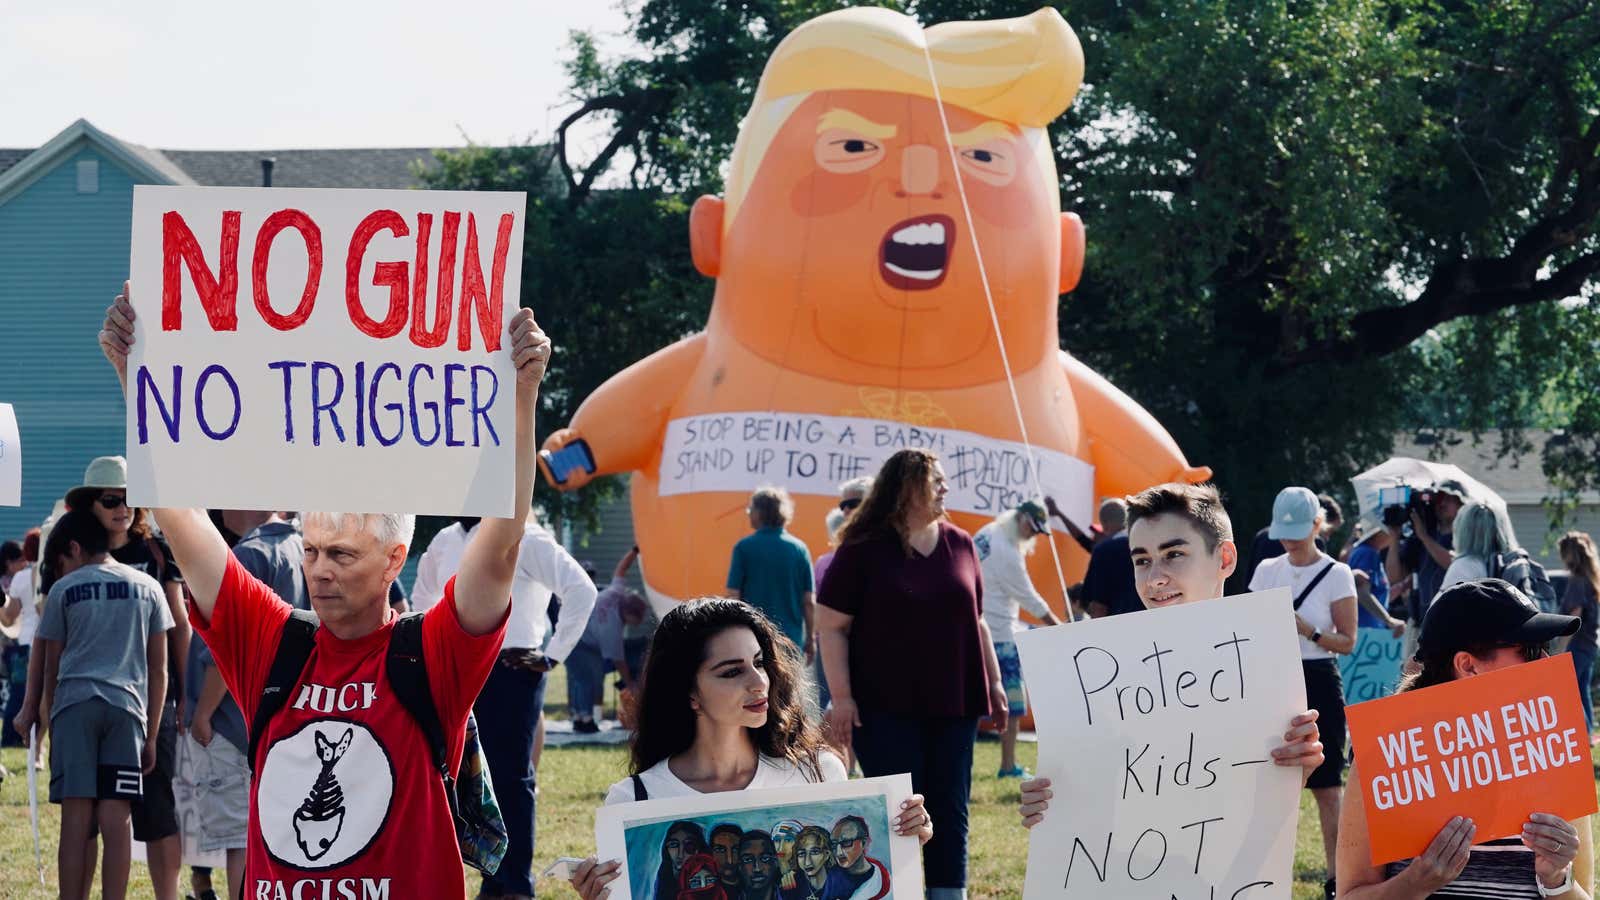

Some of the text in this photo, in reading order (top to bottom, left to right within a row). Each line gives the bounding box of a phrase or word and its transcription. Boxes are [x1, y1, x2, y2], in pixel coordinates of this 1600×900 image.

[160, 208, 515, 353] NO GUN
[135, 360, 501, 448] NO TRIGGER
[683, 416, 945, 452] STOP BEING A BABY!
[673, 448, 872, 480] STAND UP TO THE
[65, 582, 102, 607] JUST
[106, 581, 130, 600] DO
[1072, 631, 1250, 726] Protect
[1371, 727, 1582, 810] GUN VIOLENCE
[1377, 695, 1558, 769] WE CAN END
[1064, 817, 1224, 889] NOT
